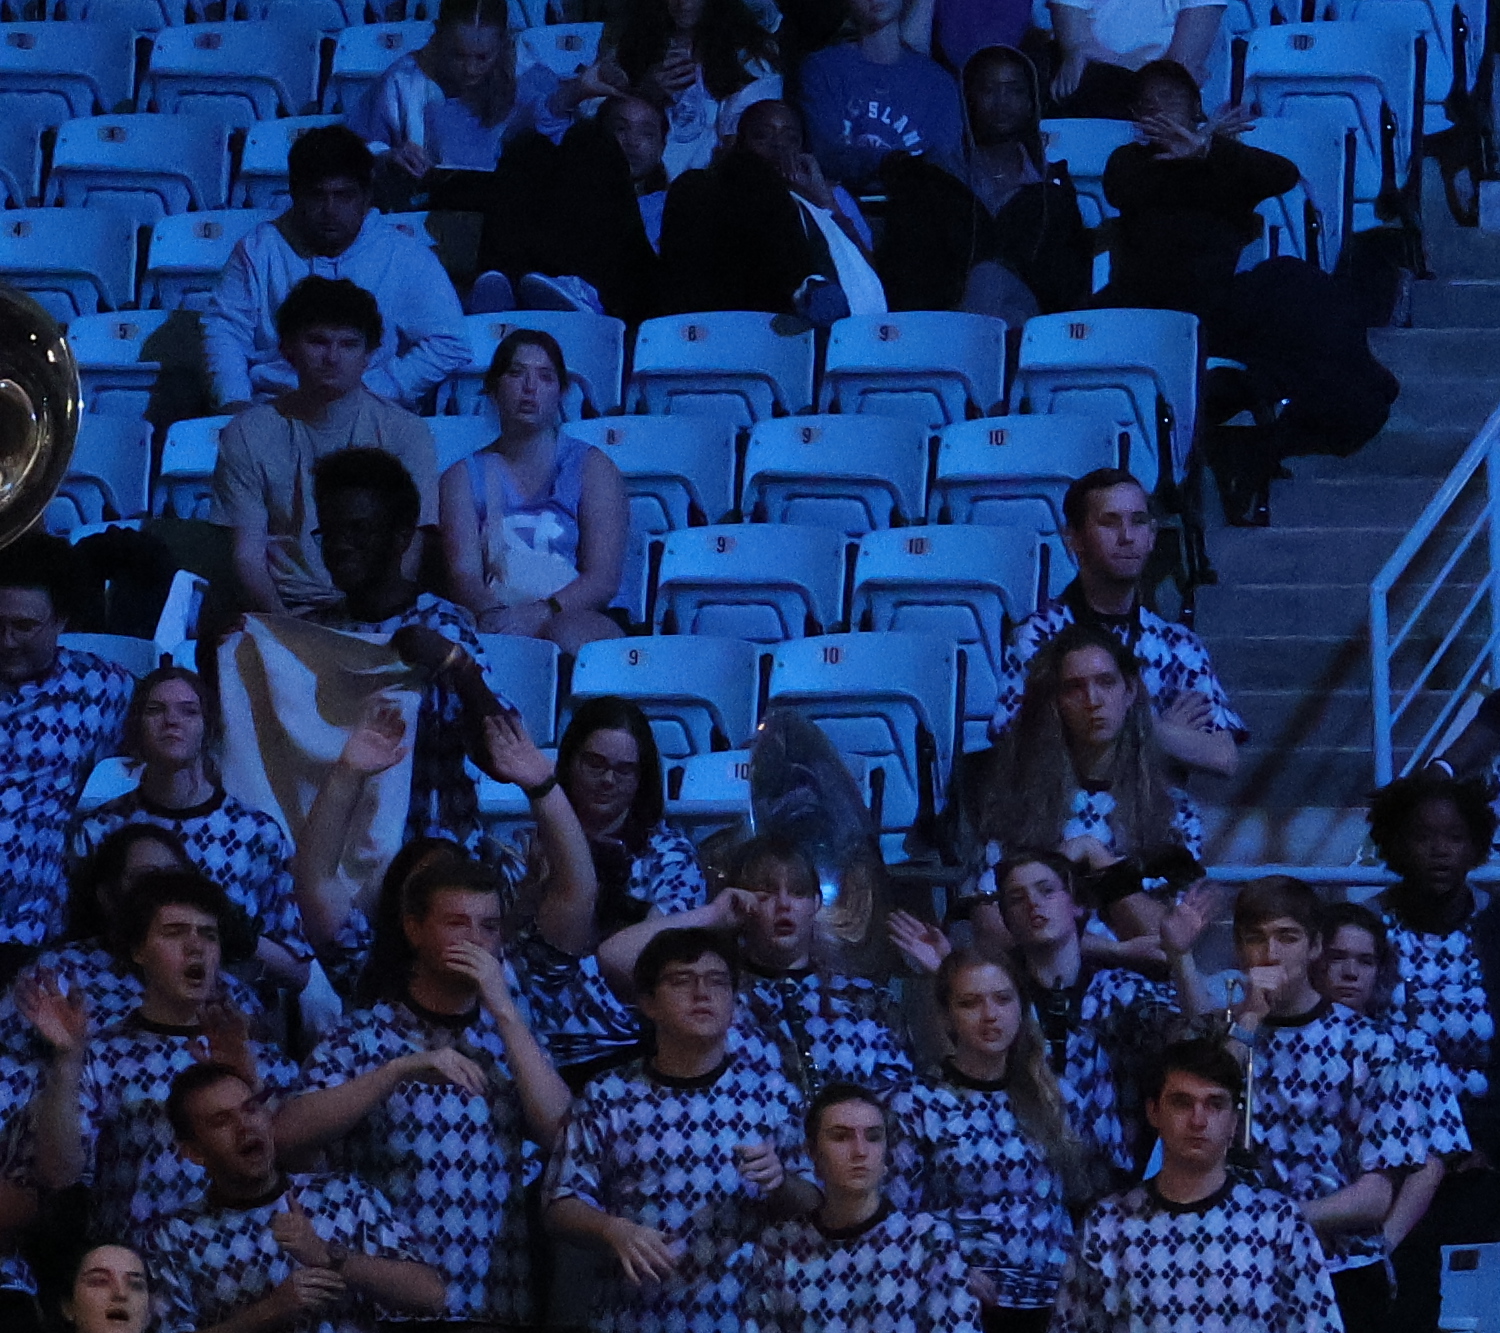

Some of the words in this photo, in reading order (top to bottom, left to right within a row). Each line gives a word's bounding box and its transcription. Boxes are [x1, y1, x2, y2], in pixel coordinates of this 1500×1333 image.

[989, 429, 1004, 446] 10
[628, 649, 639, 666] 9
[823, 646, 840, 664] 10
[735, 762, 750, 780] 10
